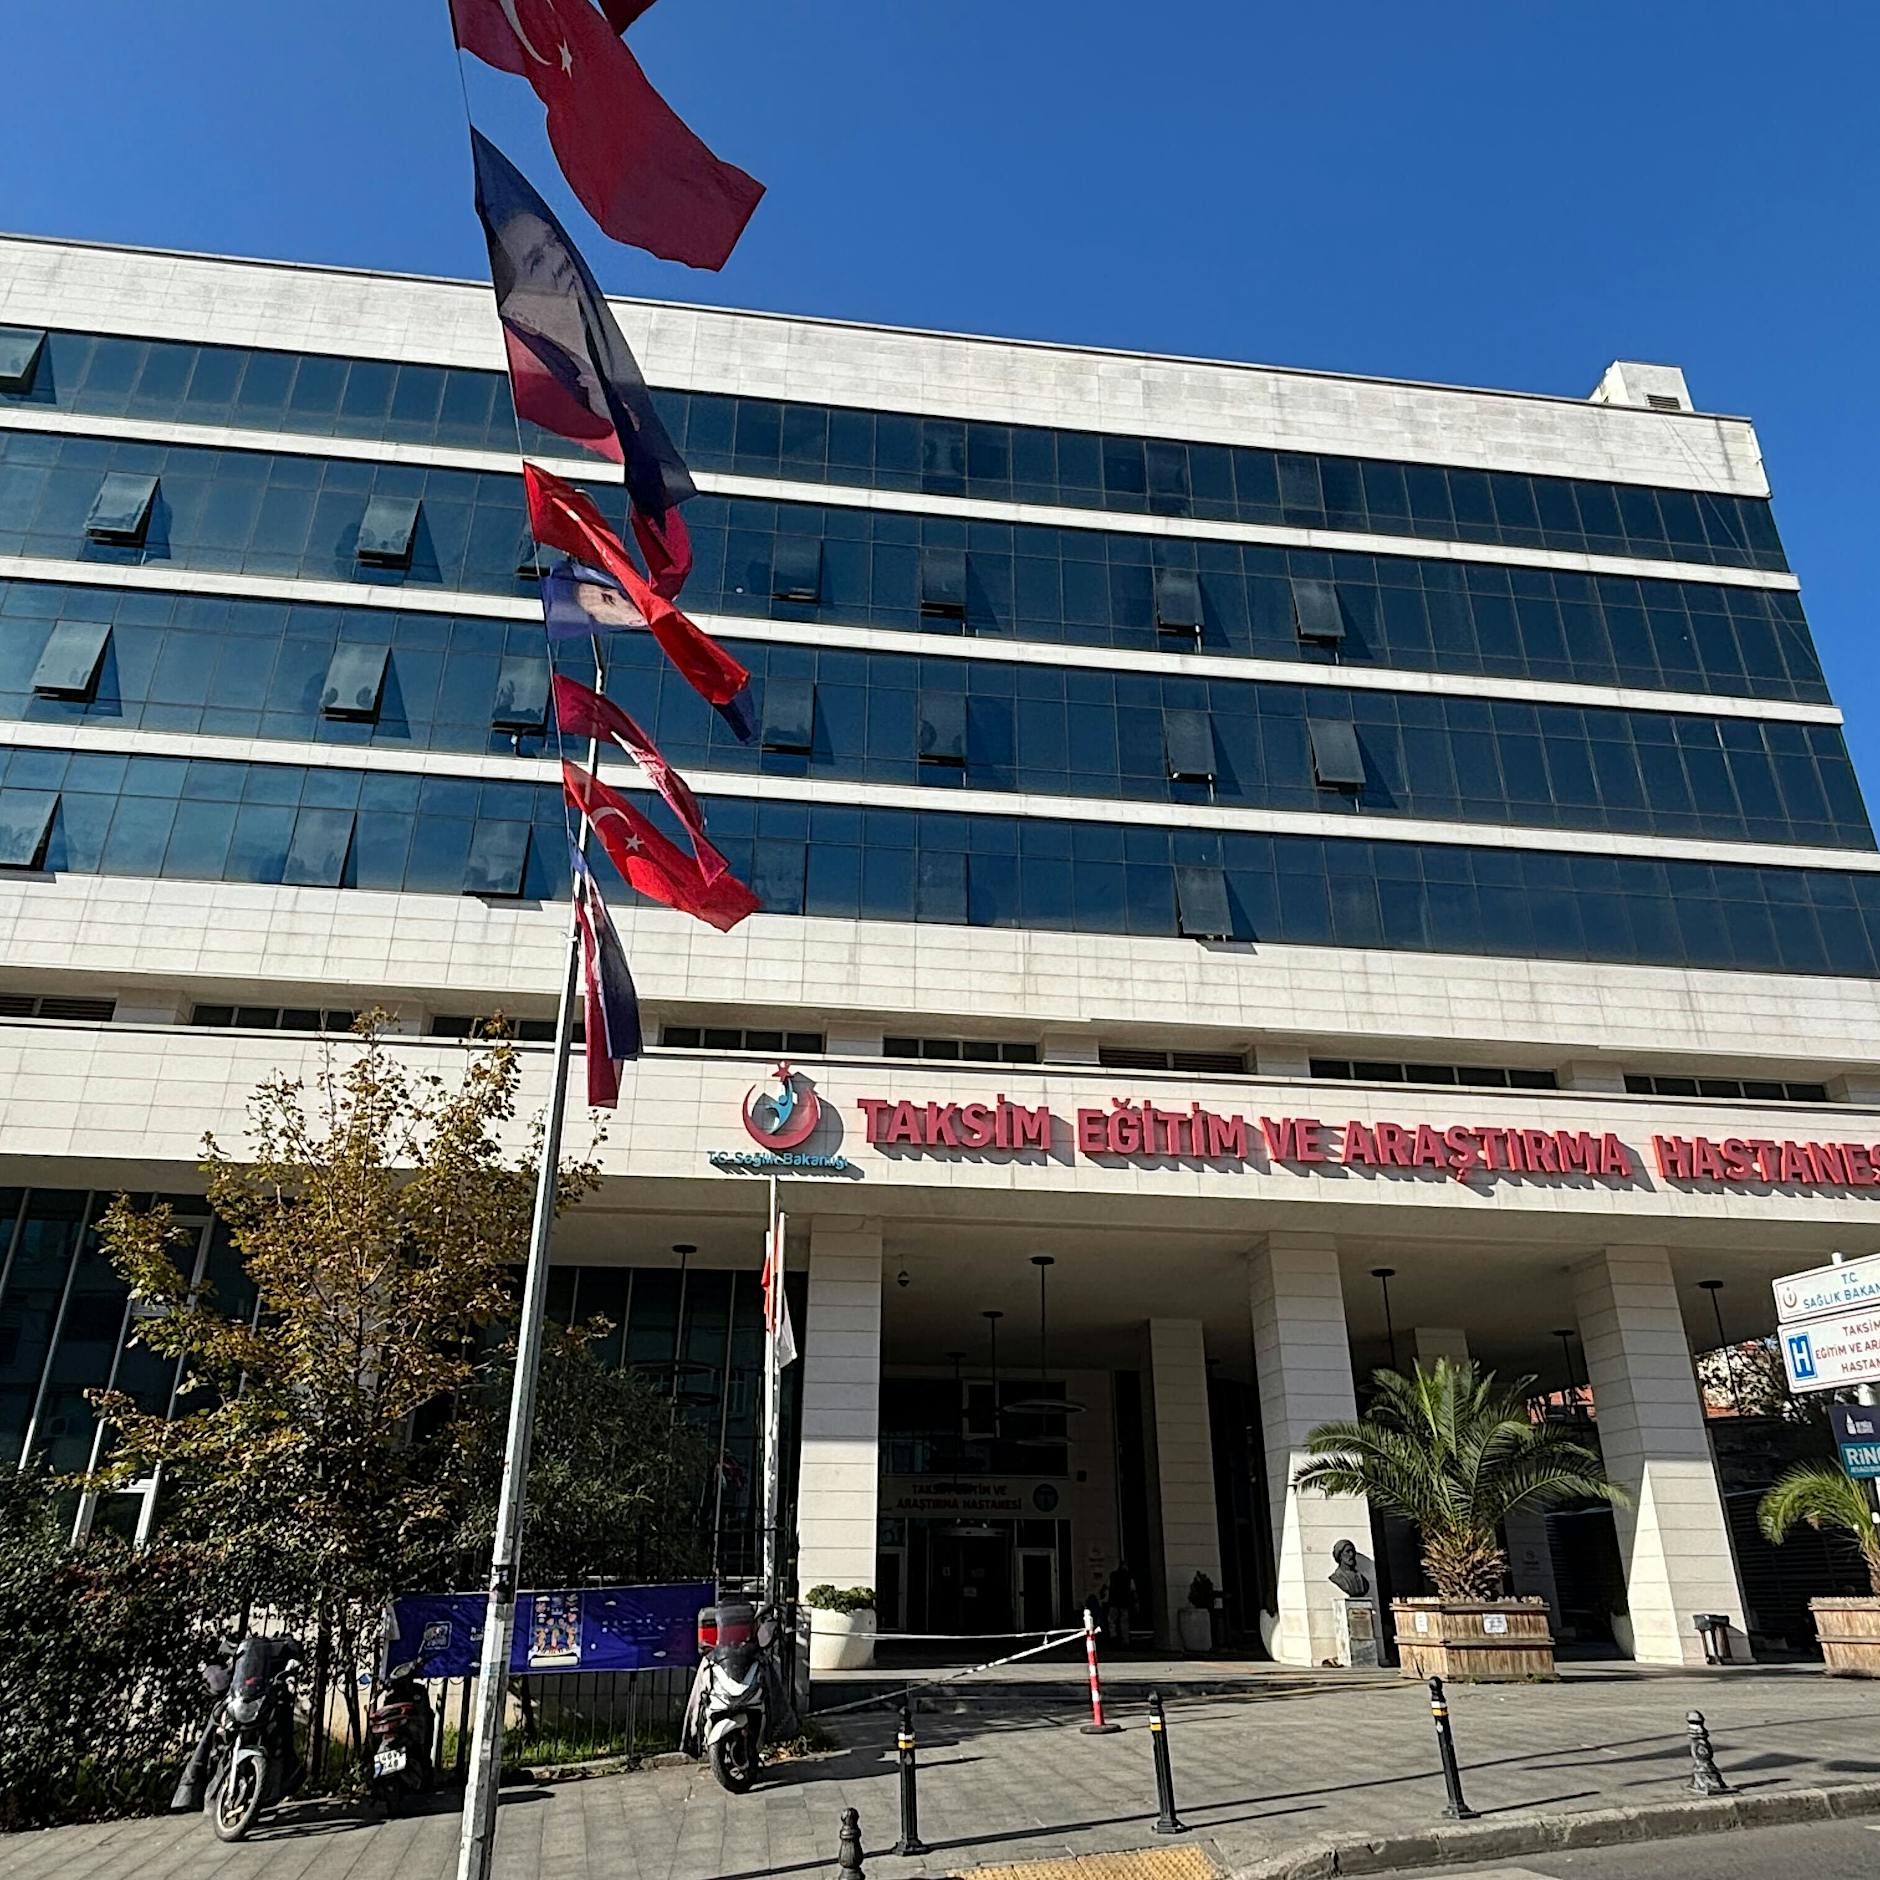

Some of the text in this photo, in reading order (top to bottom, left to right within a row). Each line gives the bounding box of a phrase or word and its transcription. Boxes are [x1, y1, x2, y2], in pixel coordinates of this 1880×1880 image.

[857, 1093, 1051, 1151] TAKSİM
[1077, 1097, 1249, 1159] EĞİTİM
[1260, 1116, 1326, 1164] VE
[1341, 1119, 1634, 1182] ARAŞTIRMA
[1803, 1291, 1842, 1310] SAĞLIK
[1791, 1340, 1813, 1374] H
[1815, 1339, 1880, 1360] EĞİTİM VE AR
